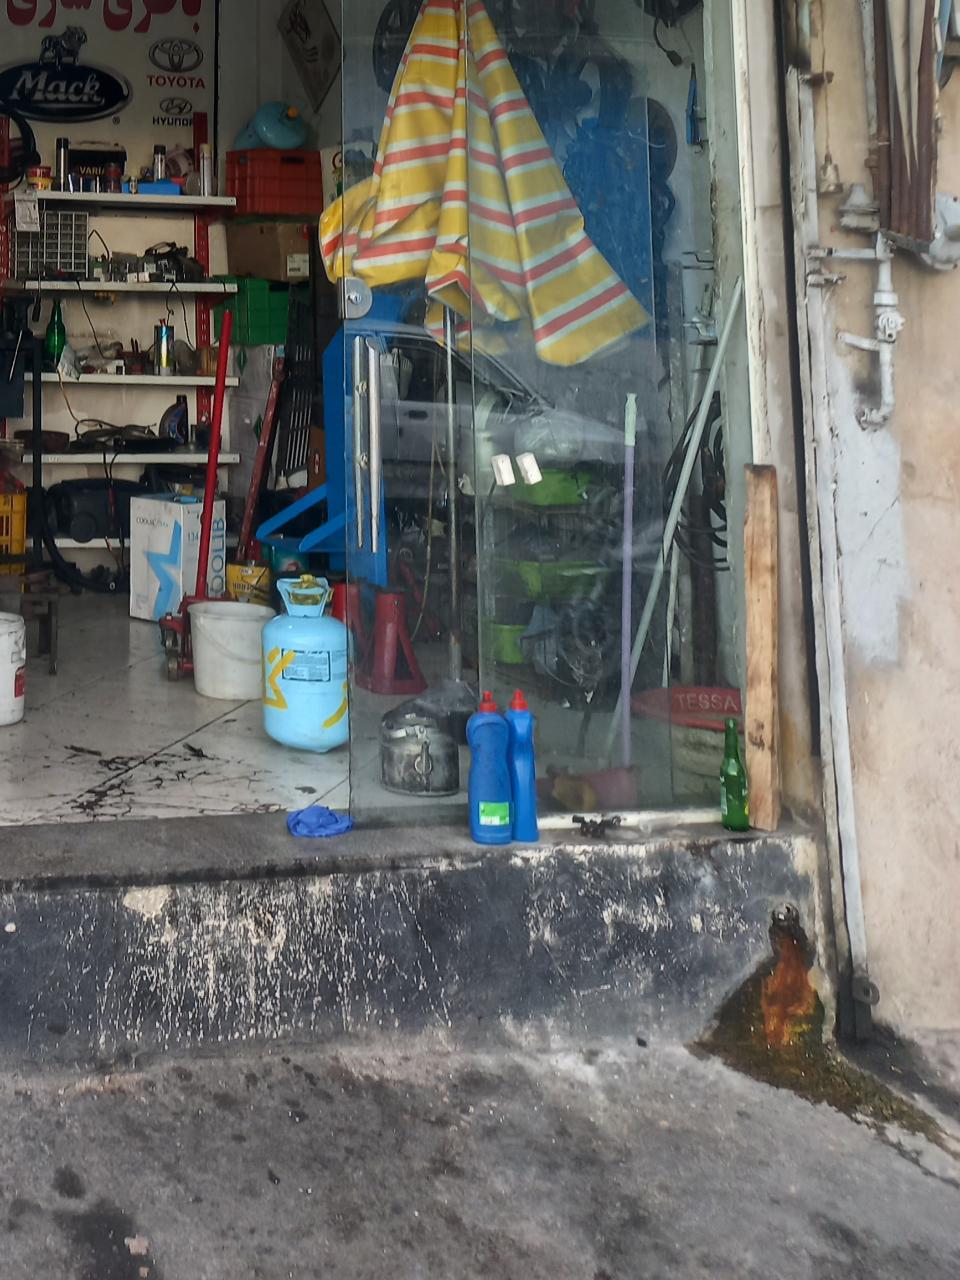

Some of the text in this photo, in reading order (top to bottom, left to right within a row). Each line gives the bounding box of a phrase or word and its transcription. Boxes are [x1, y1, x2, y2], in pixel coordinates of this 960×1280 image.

[8, 71, 106, 108] Mack
[146, 74, 207, 90] TOYOTA
[674, 692, 739, 712] TESSA
